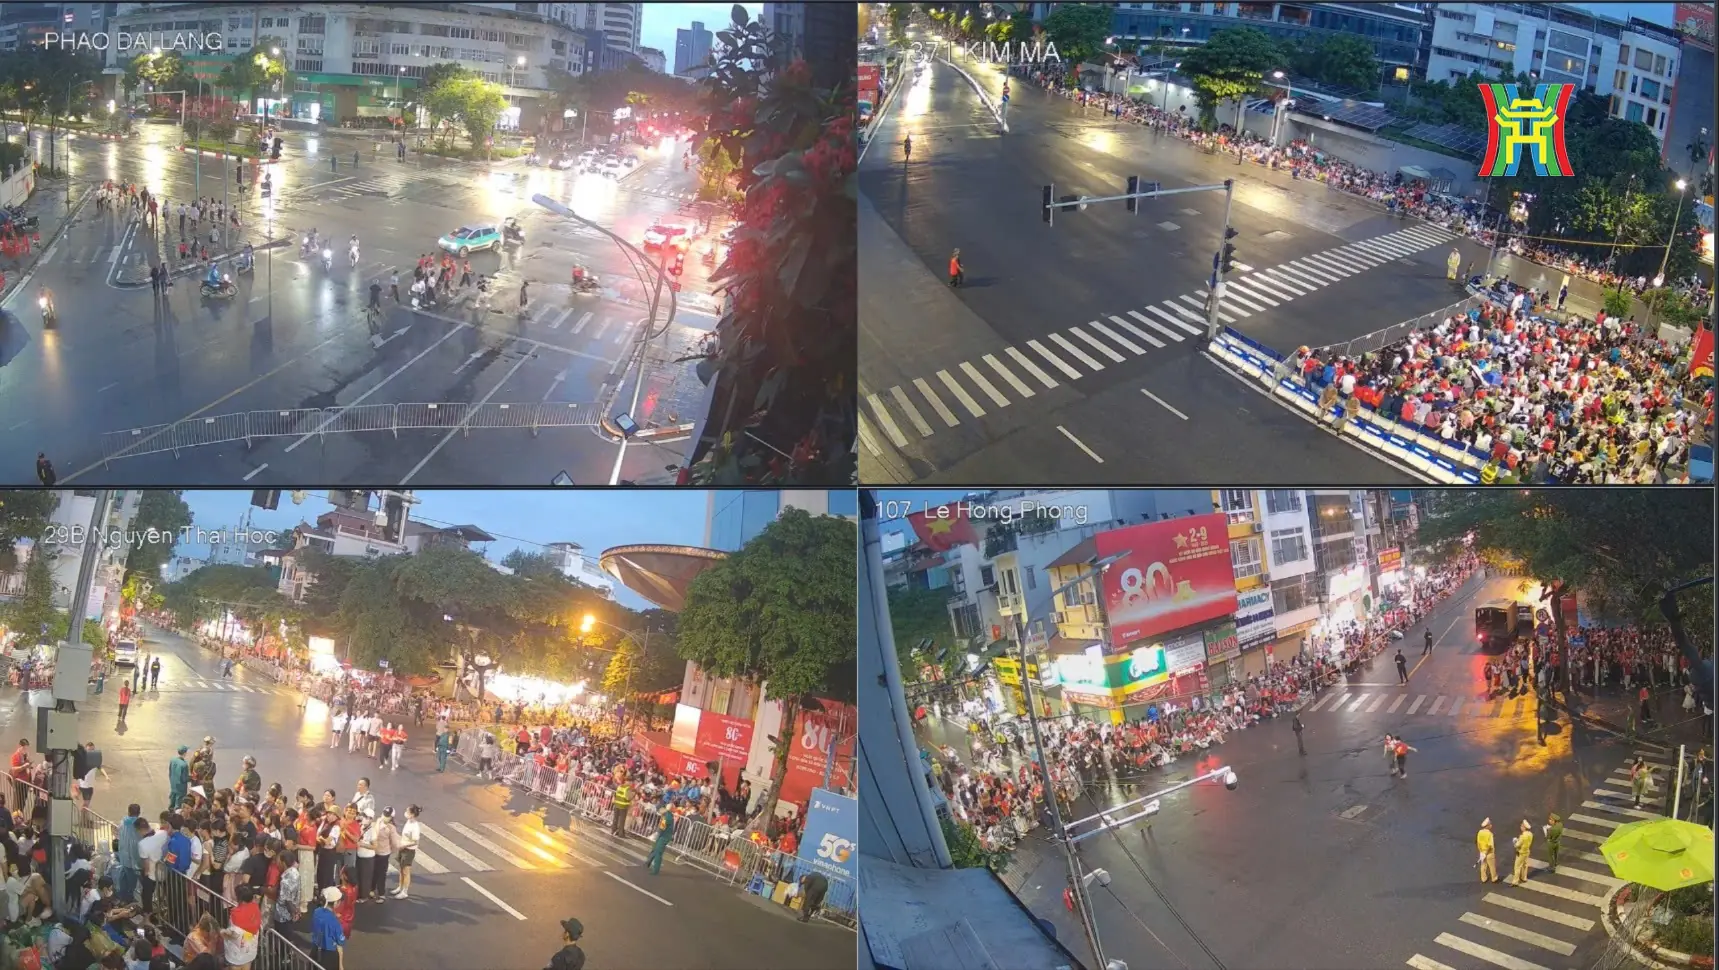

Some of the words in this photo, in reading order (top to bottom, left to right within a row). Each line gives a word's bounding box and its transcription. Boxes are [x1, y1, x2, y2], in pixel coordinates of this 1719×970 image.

[1189, 526, 1208, 543] 2-9
[1120, 561, 1172, 606] 80
[821, 803, 840, 814] VNPT
